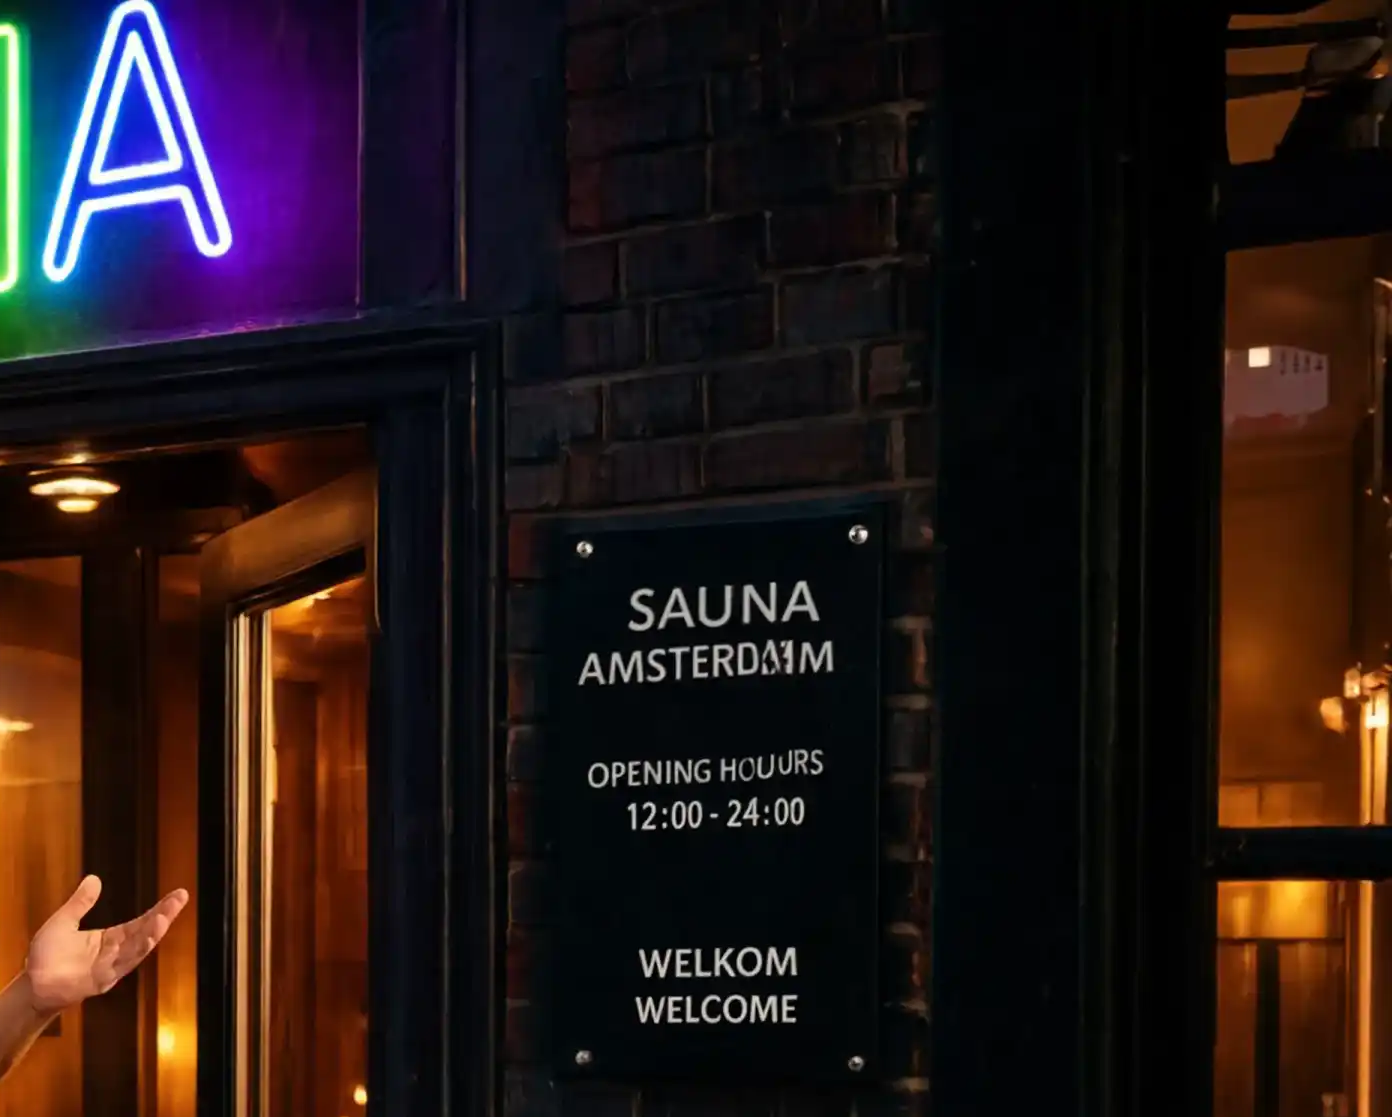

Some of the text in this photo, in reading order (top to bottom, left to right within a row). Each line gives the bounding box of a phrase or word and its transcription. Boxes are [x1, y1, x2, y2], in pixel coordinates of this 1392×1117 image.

[628, 580, 820, 632] SAUNA
[587, 749, 824, 789] OPENING HOUURS
[627, 800, 703, 831] 12:00
[726, 796, 805, 828] 24:00
[638, 946, 798, 979] WELKOM
[635, 994, 798, 1025] WELCOME
